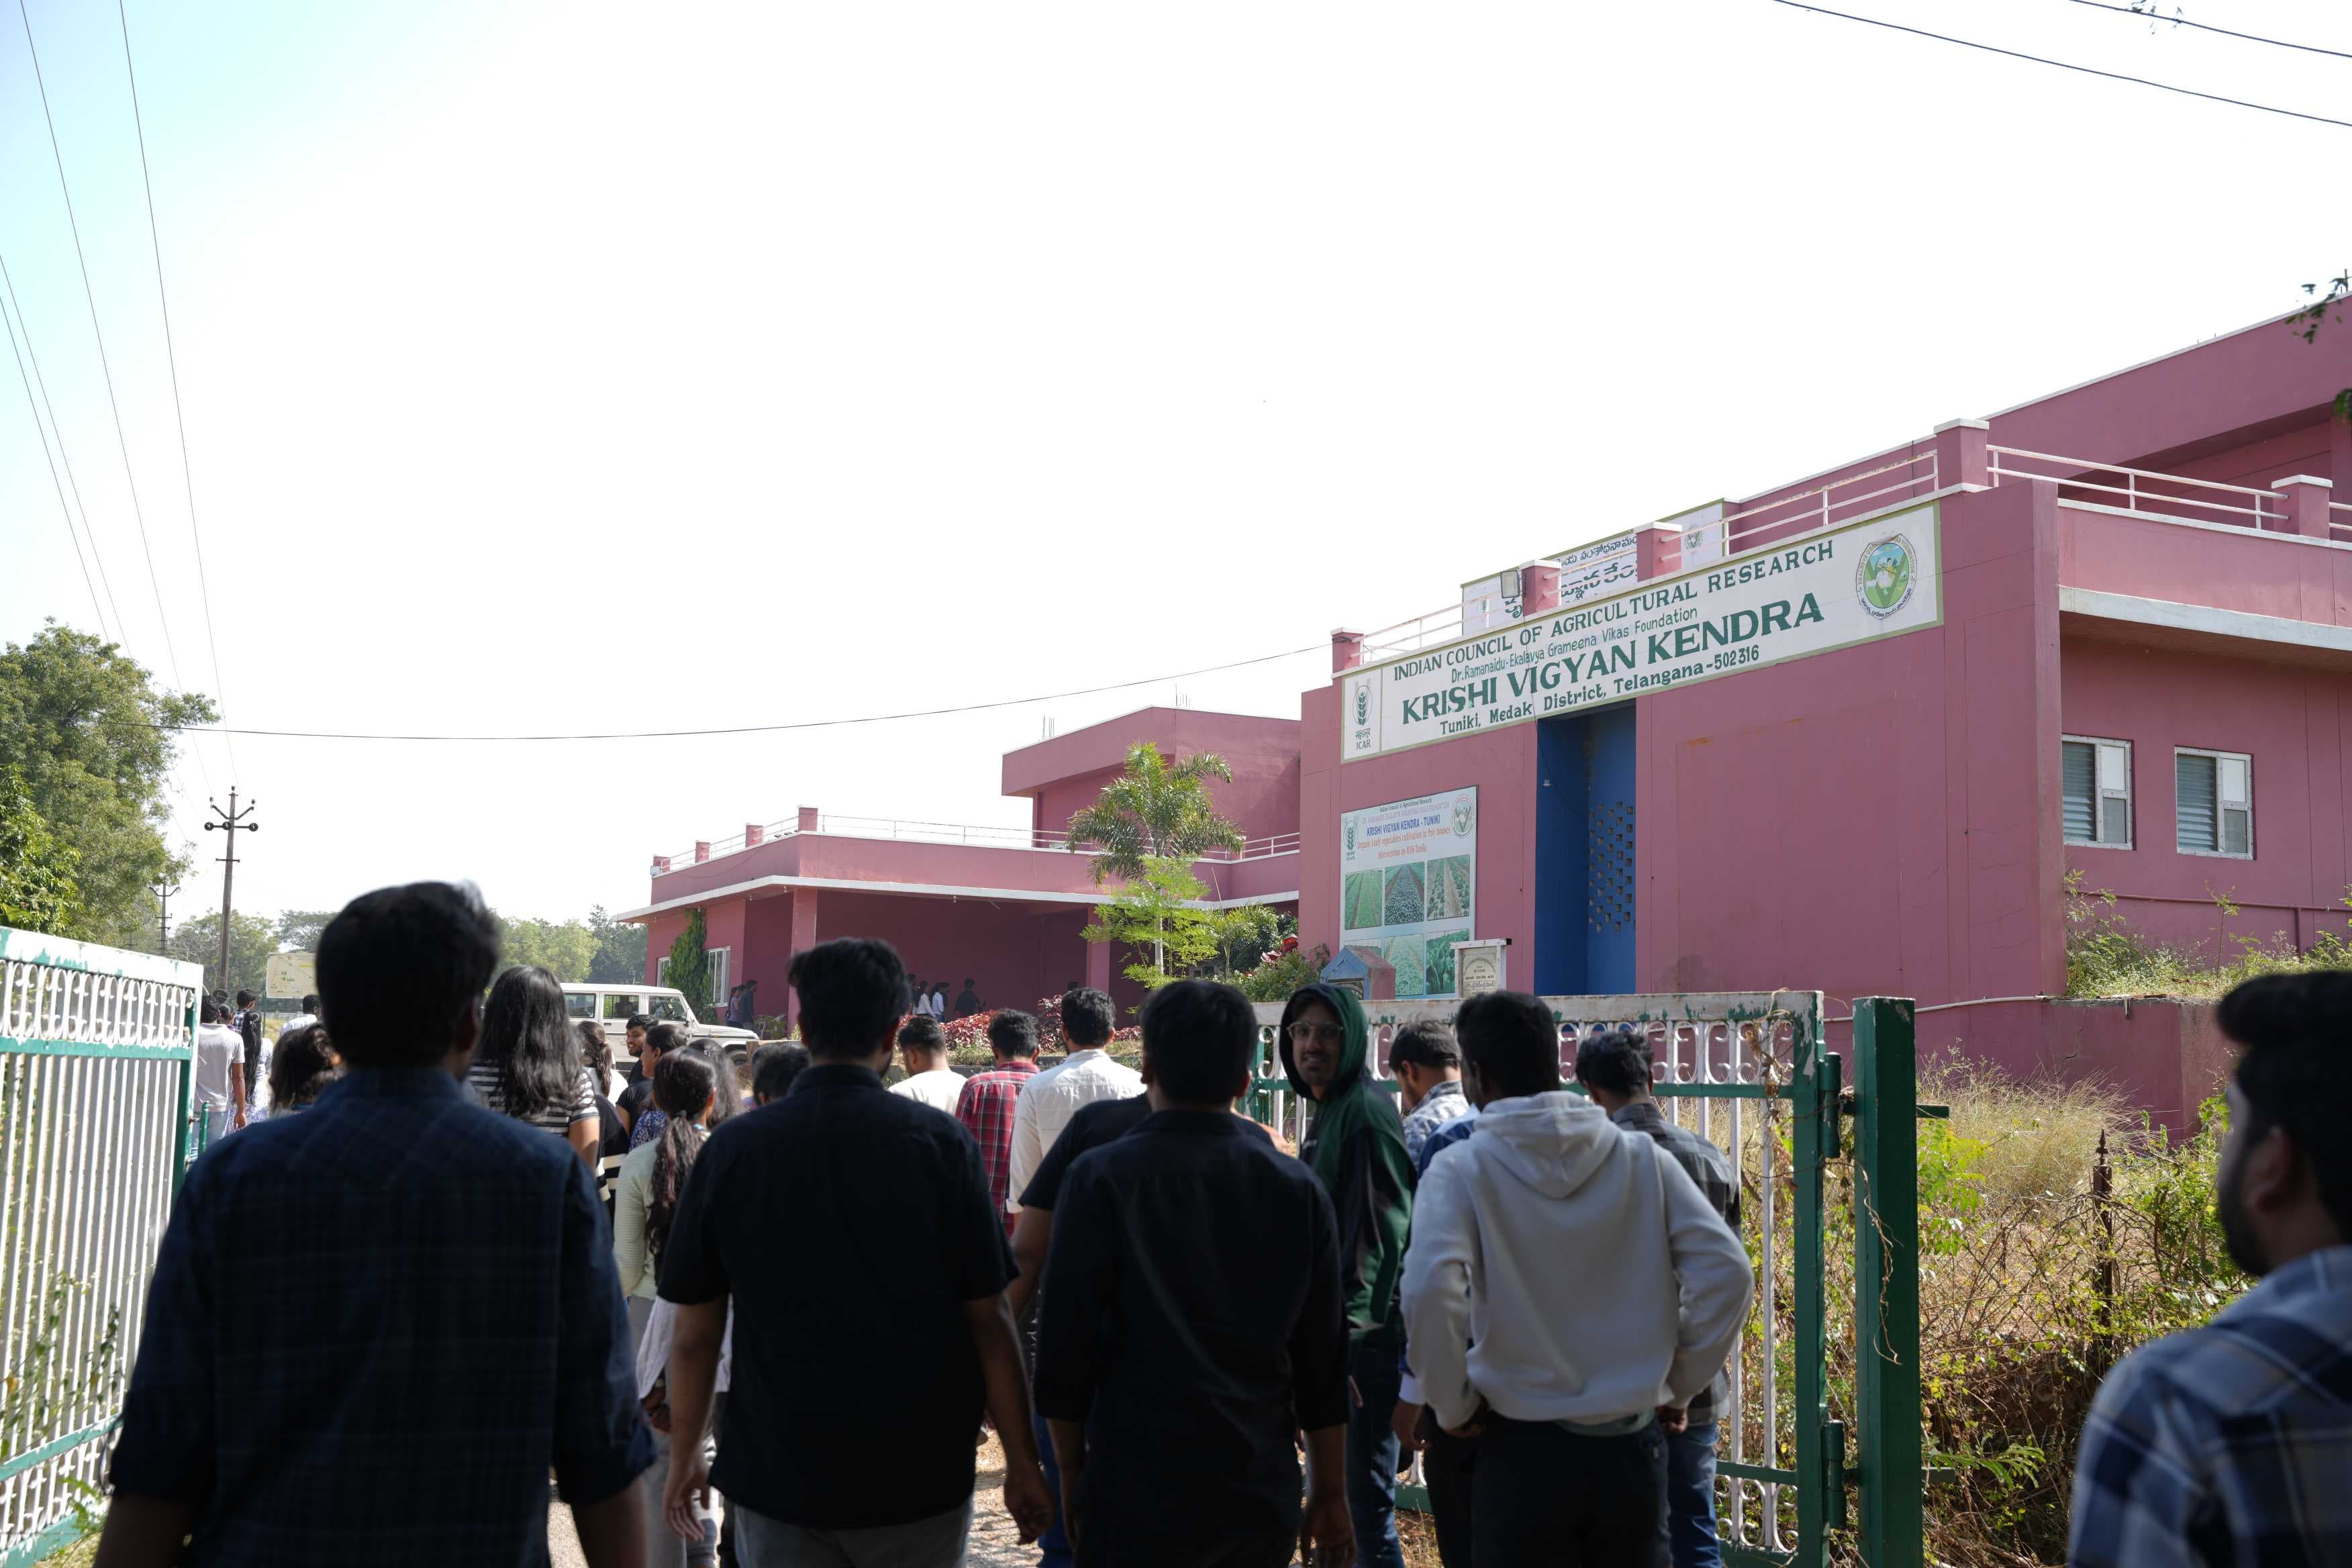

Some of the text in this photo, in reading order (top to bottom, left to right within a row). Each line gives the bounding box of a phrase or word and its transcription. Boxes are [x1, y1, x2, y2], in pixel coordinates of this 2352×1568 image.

[1394, 540, 1834, 681] INDIAN COUNCIL OF AGRICULTURAL RESEARCH
[1548, 635, 1597, 658] Grameena
[1602, 625, 1629, 640] Vikas
[1634, 607, 1698, 634] Foundation
[1402, 676, 1498, 725] KRISHI
[1506, 640, 1636, 697] VIGYAN
[1647, 592, 1824, 665] KENDRA
[1440, 712, 1481, 735] Tuniki,
[1489, 701, 1532, 724] Medak
[1544, 683, 1607, 711] District,
[1356, 739, 1371, 750] ICAR
[1367, 826, 1382, 836] KRISHI
[1383, 821, 1400, 834] VIGYAN
[1401, 818, 1420, 831] KENDRA
[1424, 814, 1440, 826] TUNIKI
